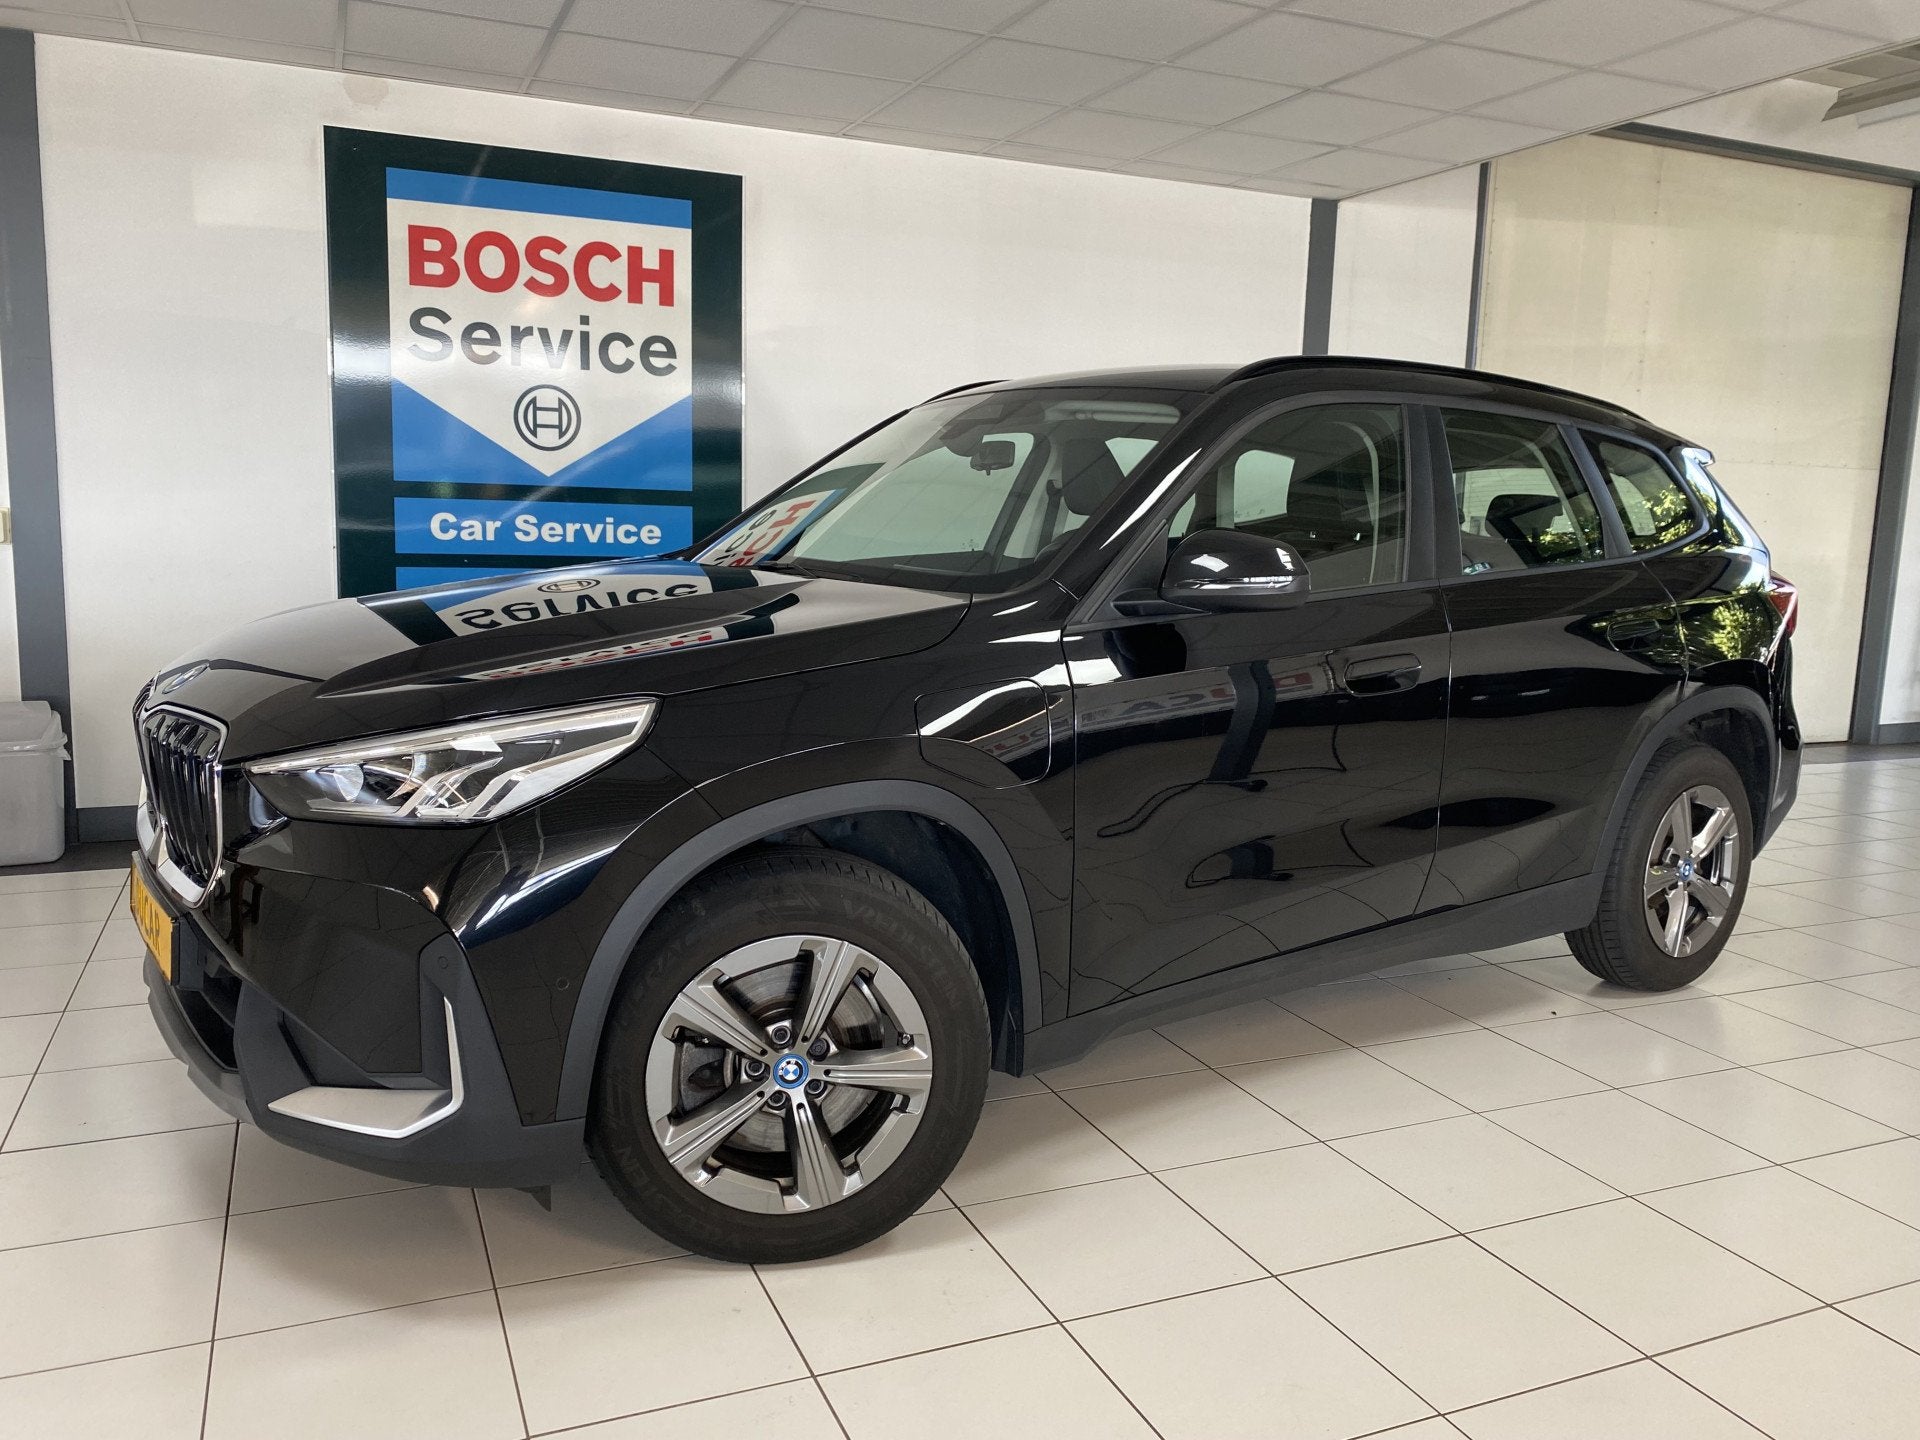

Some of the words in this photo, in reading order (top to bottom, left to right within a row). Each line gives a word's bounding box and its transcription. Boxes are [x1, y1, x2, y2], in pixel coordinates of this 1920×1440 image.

[407, 224, 675, 307] BOSCH
[408, 306, 678, 377] Service
[430, 512, 502, 542] Car
[514, 514, 662, 545] Service
